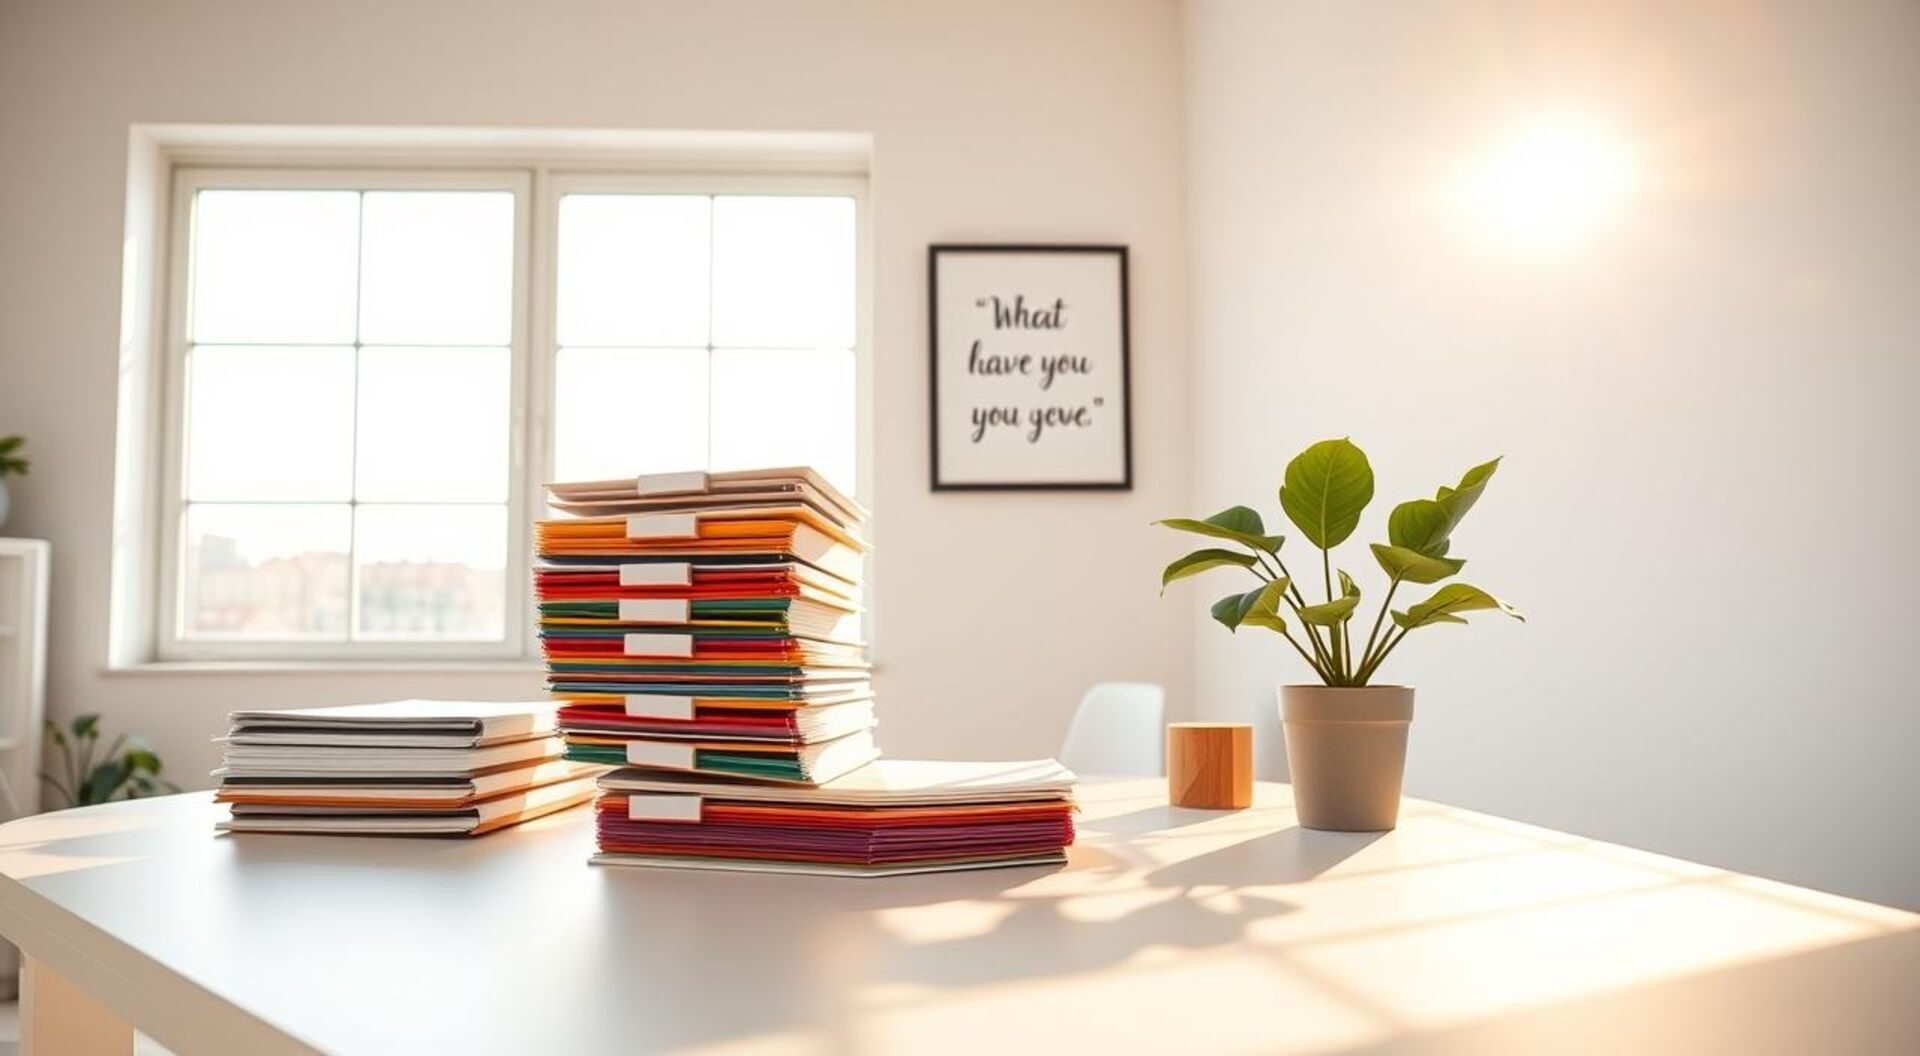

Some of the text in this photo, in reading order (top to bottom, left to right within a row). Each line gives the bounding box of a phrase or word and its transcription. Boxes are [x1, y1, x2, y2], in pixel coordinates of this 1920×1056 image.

[968, 339, 1092, 391] have you
[971, 406, 1020, 443] you
